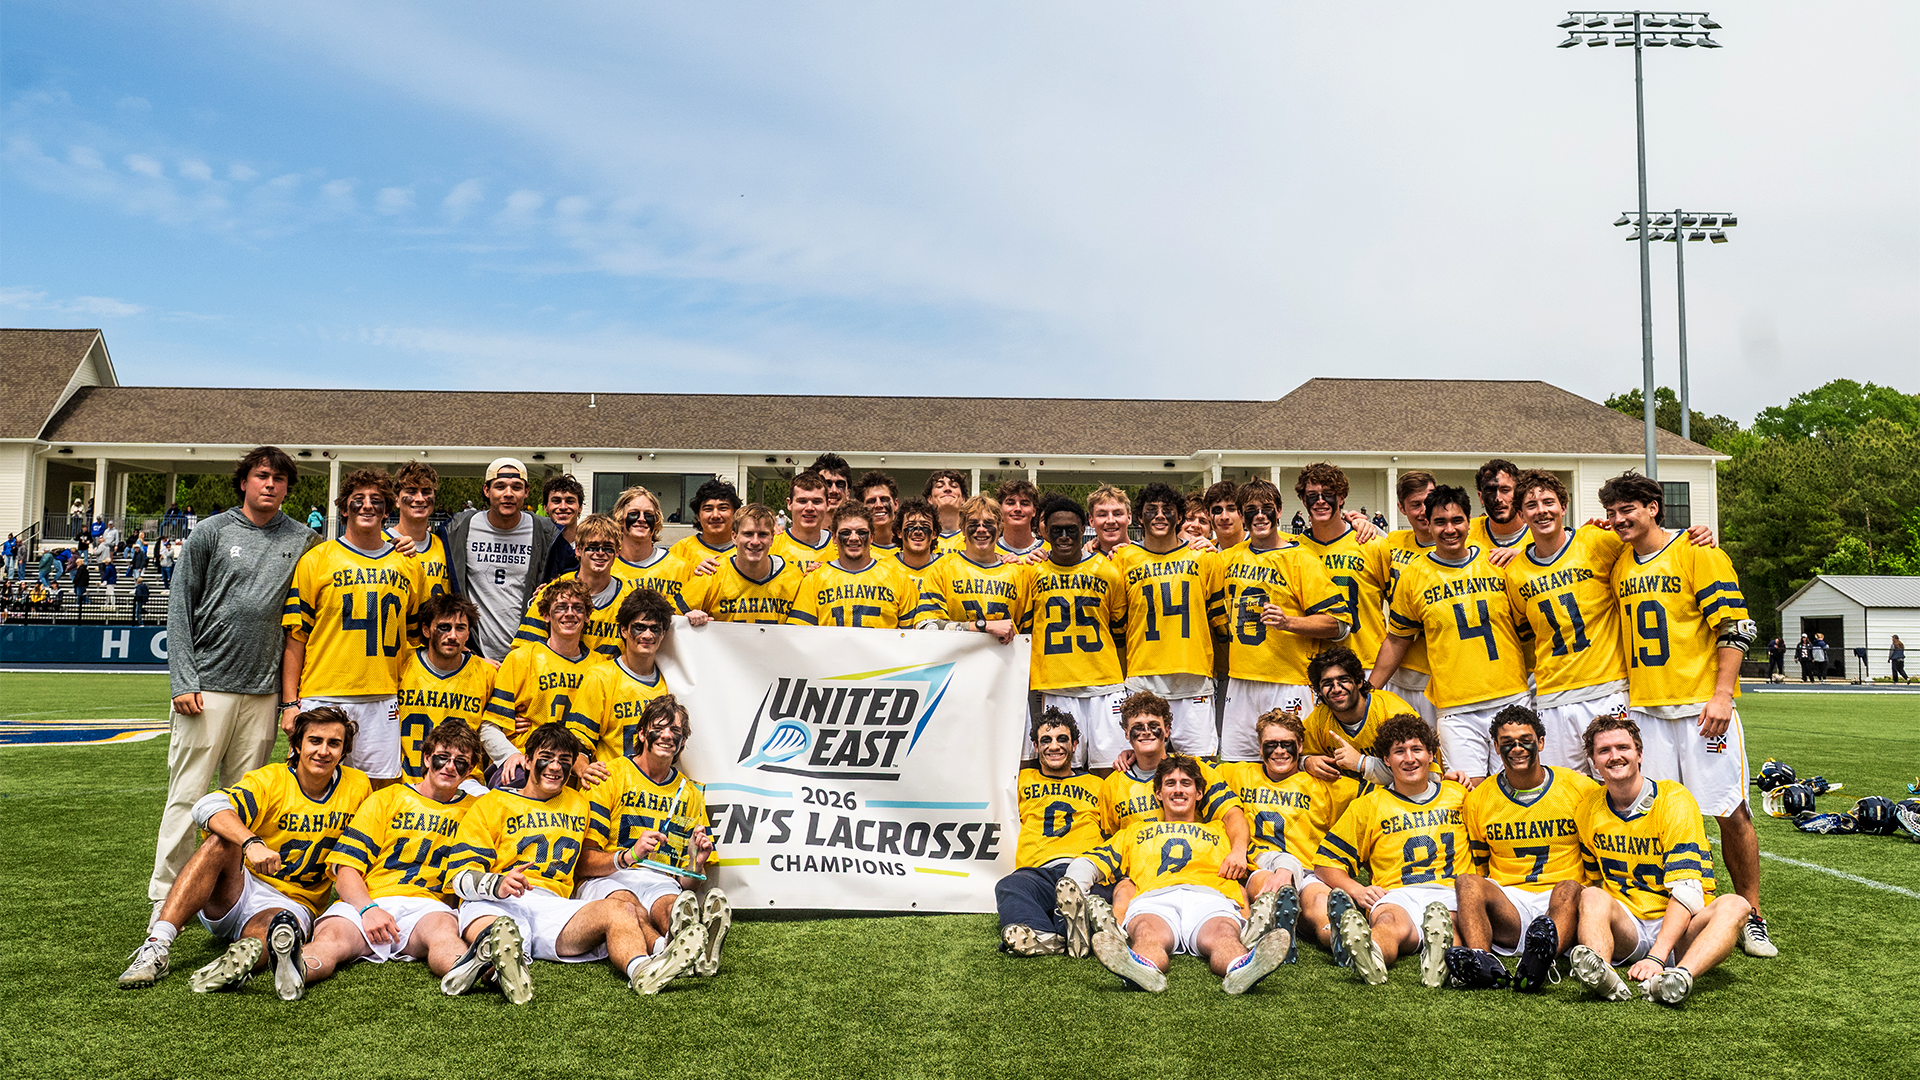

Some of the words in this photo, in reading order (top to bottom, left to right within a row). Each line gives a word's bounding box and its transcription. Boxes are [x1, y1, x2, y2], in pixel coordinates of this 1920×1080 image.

[477, 553, 526, 565] LACROSSE
[1128, 559, 1200, 585] SEAHAWKS
[1225, 563, 1288, 587] EAHAWKS
[1619, 574, 1682, 599] EAHAWKS
[817, 584, 895, 606] SEAHAWKS
[1423, 577, 1506, 605] SEAHAWKS
[719, 597, 794, 616] SEAHAWKS
[1141, 580, 1190, 642] 14
[342, 591, 402, 658] 40
[1043, 595, 1104, 656] 25
[1452, 599, 1500, 662] 4
[1537, 592, 1592, 657] 11
[1624, 600, 1671, 669] 19
[101, 629, 168, 659] HO
[538, 671, 584, 691] SEAH
[397, 688, 481, 714] SEAHAWKS
[769, 677, 920, 726] UNITED
[808, 728, 910, 768] EAST
[801, 786, 858, 811] 2026
[1114, 793, 1161, 820] SEAHA
[391, 811, 460, 839] SEAHAW
[506, 812, 586, 835] SEAHAWKS
[705, 803, 795, 845] EN'S
[804, 811, 1002, 861] LACROSSE
[1136, 822, 1220, 847] SEAHAWKS
[1486, 818, 1578, 841] SEAHAWKS
[1593, 832, 1663, 856] SEAHAWK
[770, 853, 907, 876] CHAMPIONS
[1401, 831, 1458, 885] 21
[1512, 845, 1550, 883] 7
